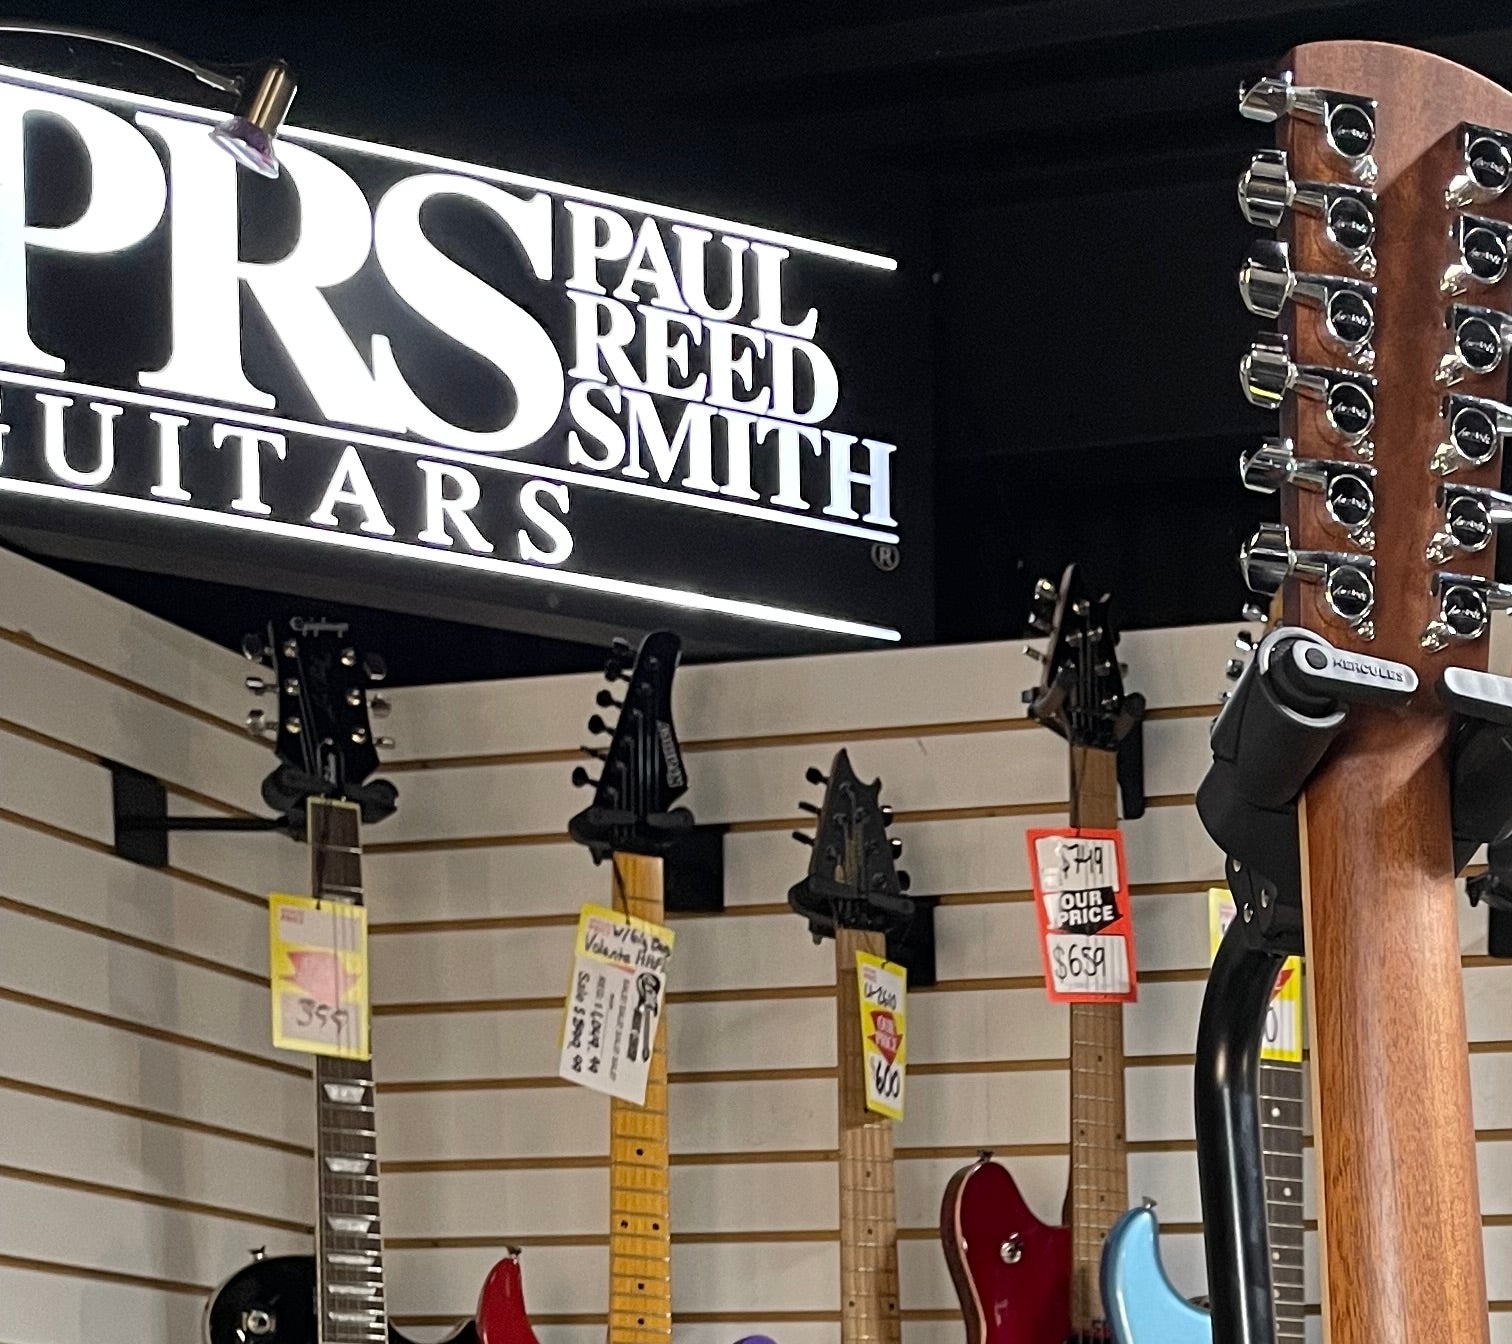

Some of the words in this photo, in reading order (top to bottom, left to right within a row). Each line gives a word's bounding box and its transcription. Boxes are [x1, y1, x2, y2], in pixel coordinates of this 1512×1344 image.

[0, 85, 566, 453] PRS
[564, 200, 819, 340] PAUL
[567, 289, 840, 425] REED
[0, 393, 576, 566] UITARS
[567, 380, 899, 528] SMITH
[1331, 656, 1404, 683] HERCULES
[1052, 943, 1107, 984] $659
[1057, 904, 1116, 929] PRICE
[1061, 889, 1104, 911] OUR
